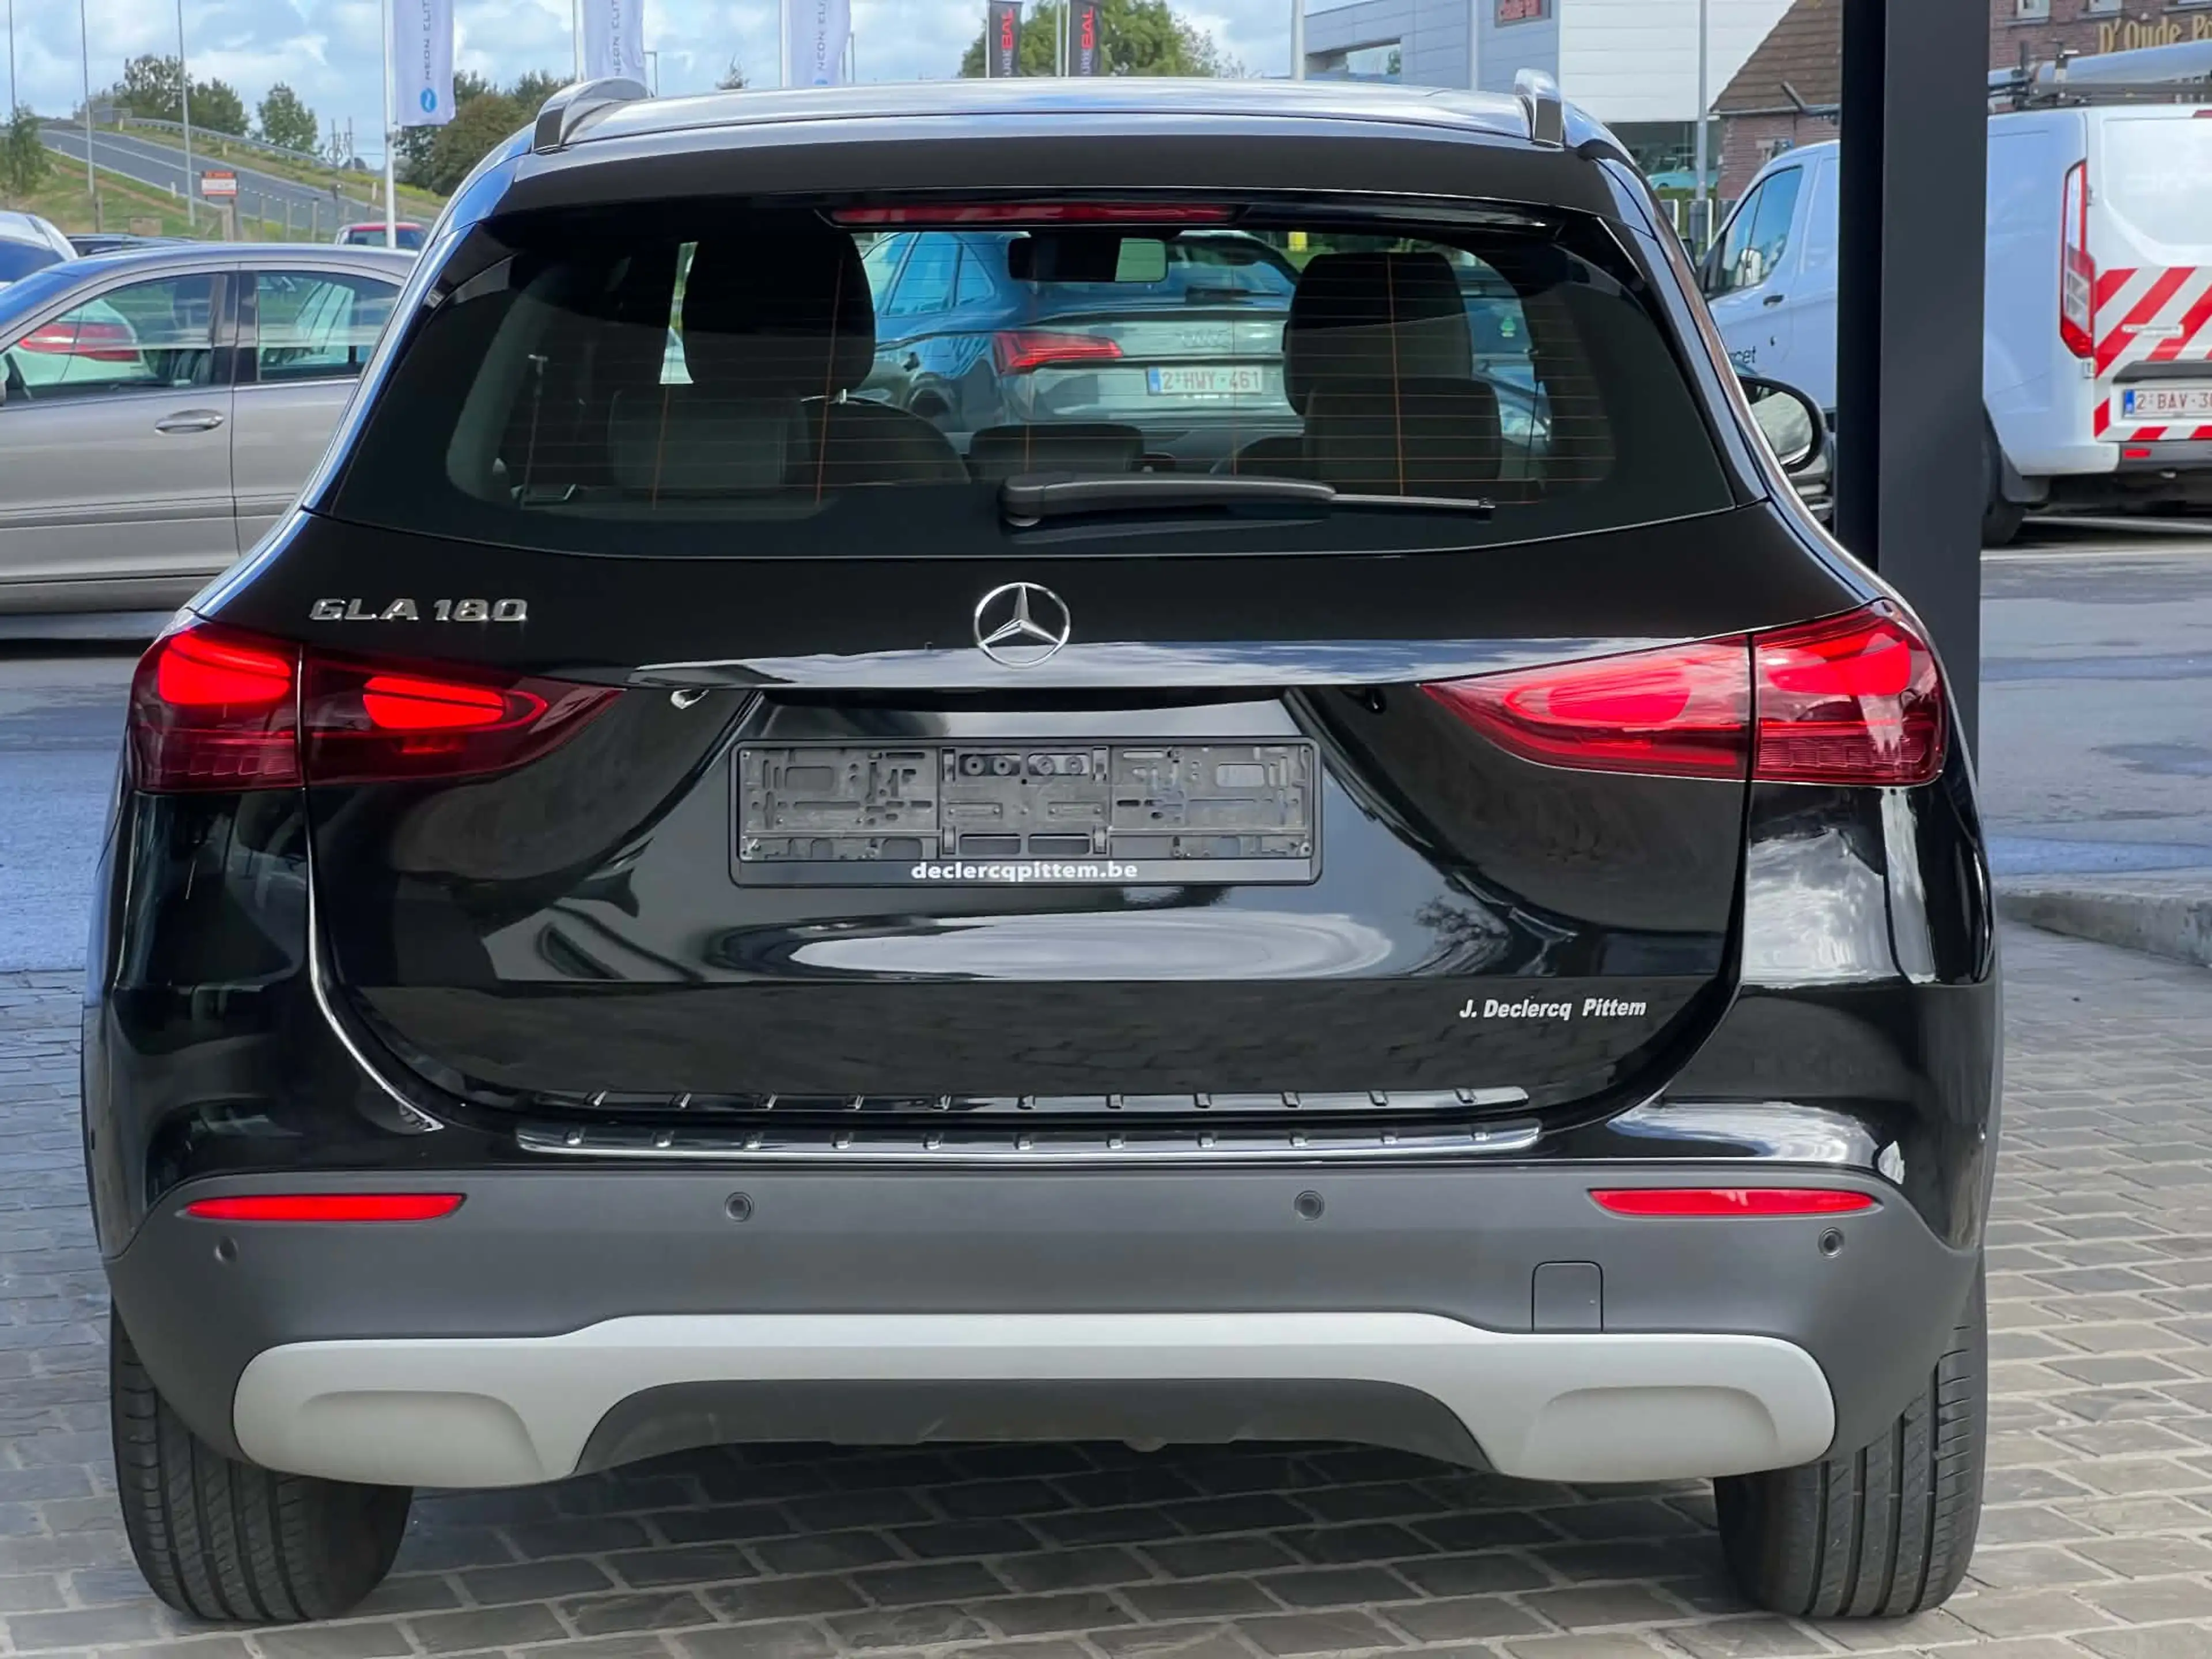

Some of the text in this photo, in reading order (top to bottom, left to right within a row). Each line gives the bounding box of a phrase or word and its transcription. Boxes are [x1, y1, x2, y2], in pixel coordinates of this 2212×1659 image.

[309, 597, 528, 622] GLA 180
[911, 861, 1138, 882] declercqpittem.be
[1459, 998, 1647, 1021] J. Declercq Pittem
